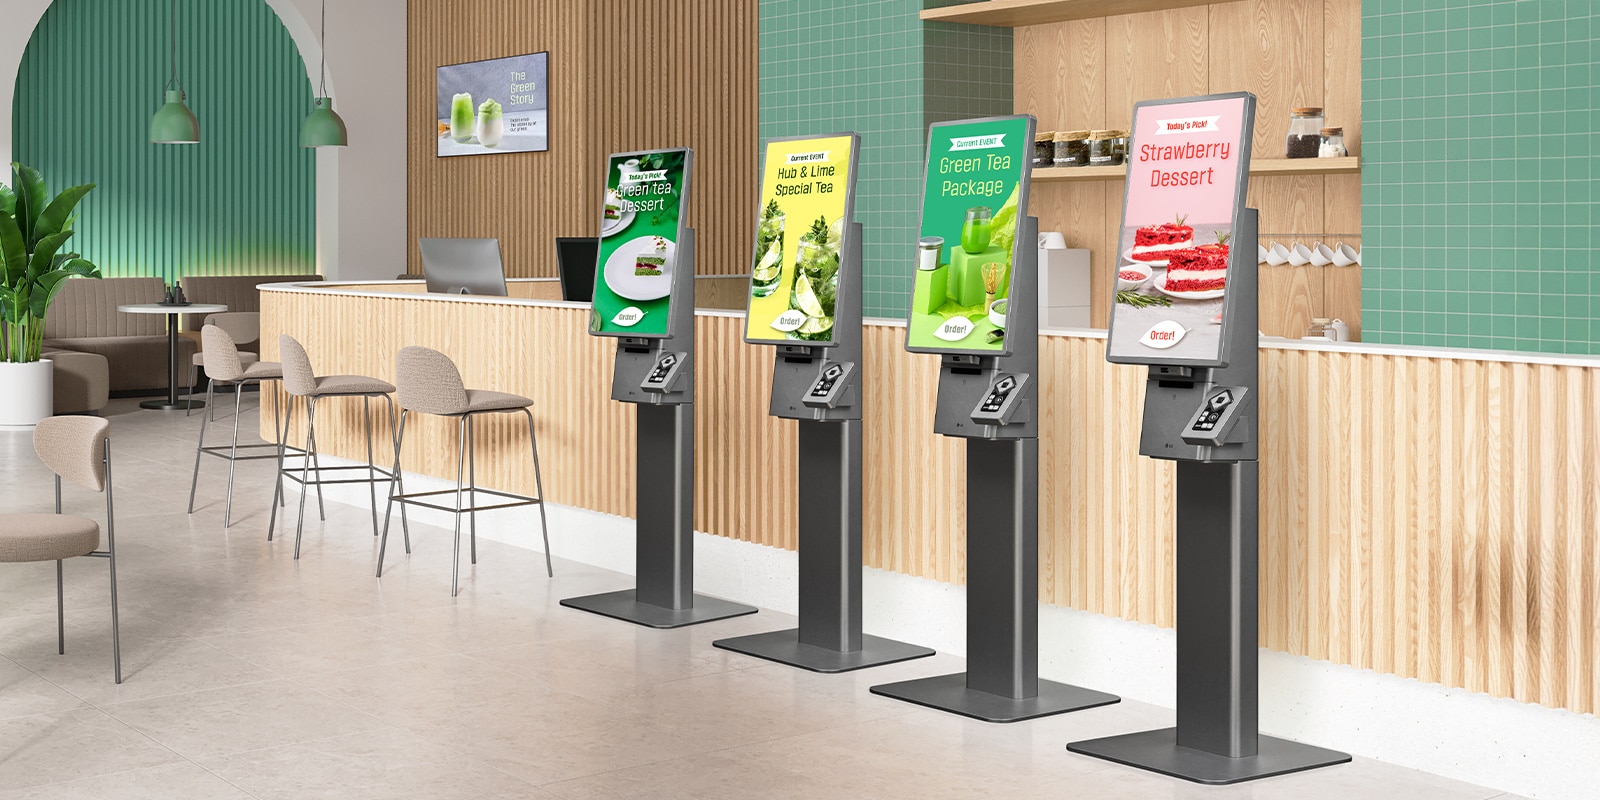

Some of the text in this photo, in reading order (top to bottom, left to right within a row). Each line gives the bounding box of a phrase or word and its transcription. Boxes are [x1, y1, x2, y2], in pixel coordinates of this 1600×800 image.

[511, 72, 526, 81] The
[510, 82, 536, 94] Green
[510, 94, 534, 105] Story
[1166, 120, 1208, 130] Today's Pick!
[956, 138, 997, 148] Current EVENT
[1140, 142, 1230, 162] Strawberry
[940, 154, 1010, 174] Green Tea
[778, 165, 834, 180] Hub & Lime
[1150, 167, 1214, 187] Dessert
[616, 182, 672, 197] Green tea
[776, 182, 833, 196] Special Tea
[942, 180, 1003, 196] Package
[620, 198, 664, 212] Dessert
[944, 325, 966, 334] Order!
[1150, 330, 1175, 340] Order!
